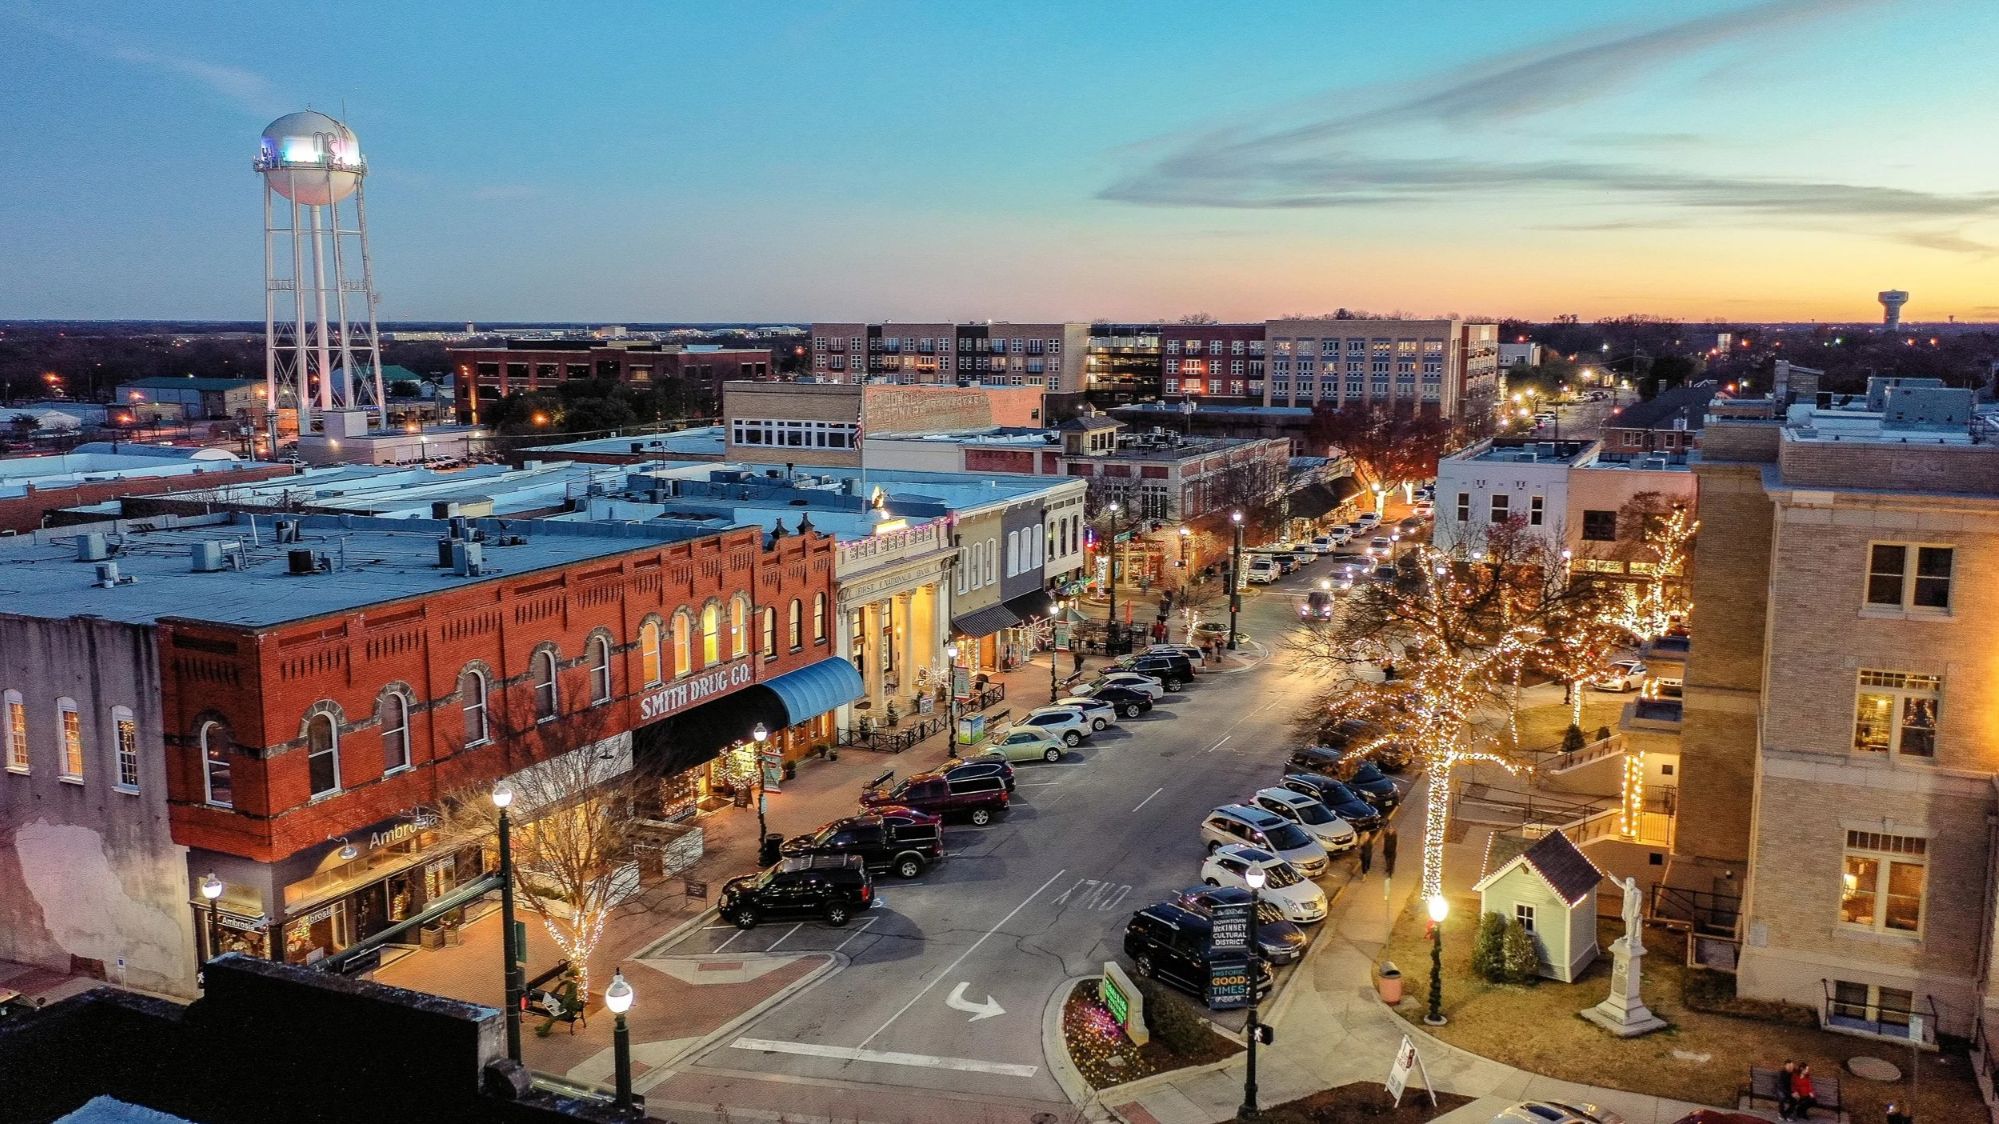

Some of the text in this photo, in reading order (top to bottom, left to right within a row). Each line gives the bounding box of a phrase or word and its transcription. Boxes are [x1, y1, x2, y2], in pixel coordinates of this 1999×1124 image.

[641, 664, 751, 720] SMITH DRUG CO.
[1212, 931, 1247, 939] CULTURAL
[1215, 938, 1245, 946] DISTRICT
[1212, 975, 1246, 986] GOOD
[1212, 985, 1246, 995] TIMES
